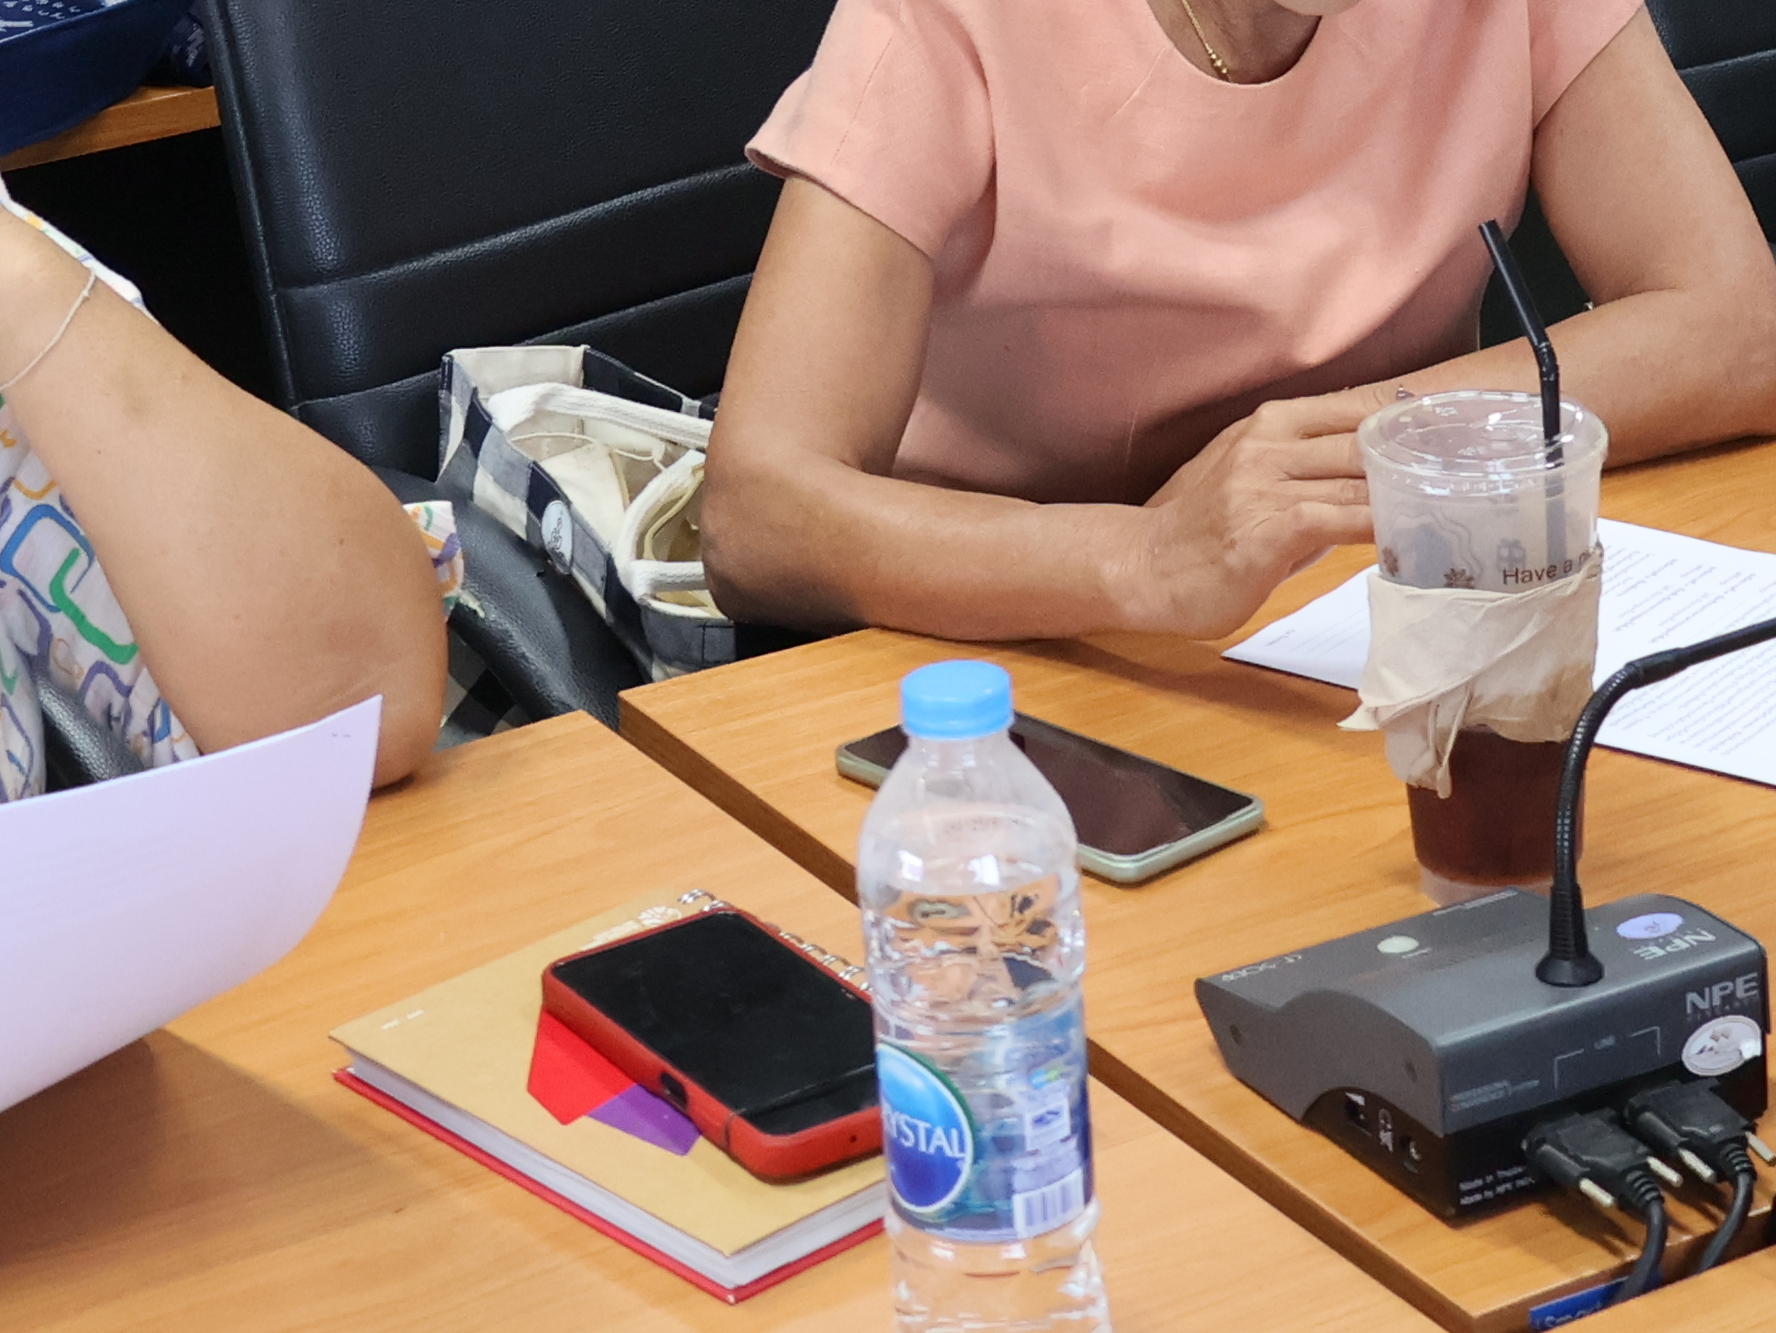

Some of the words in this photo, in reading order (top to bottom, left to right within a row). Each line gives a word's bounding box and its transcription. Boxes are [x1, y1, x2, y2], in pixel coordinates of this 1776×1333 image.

[1502, 563, 1558, 586] Have
[1563, 559, 1573, 574] a
[1685, 972, 1759, 1015] NPE
